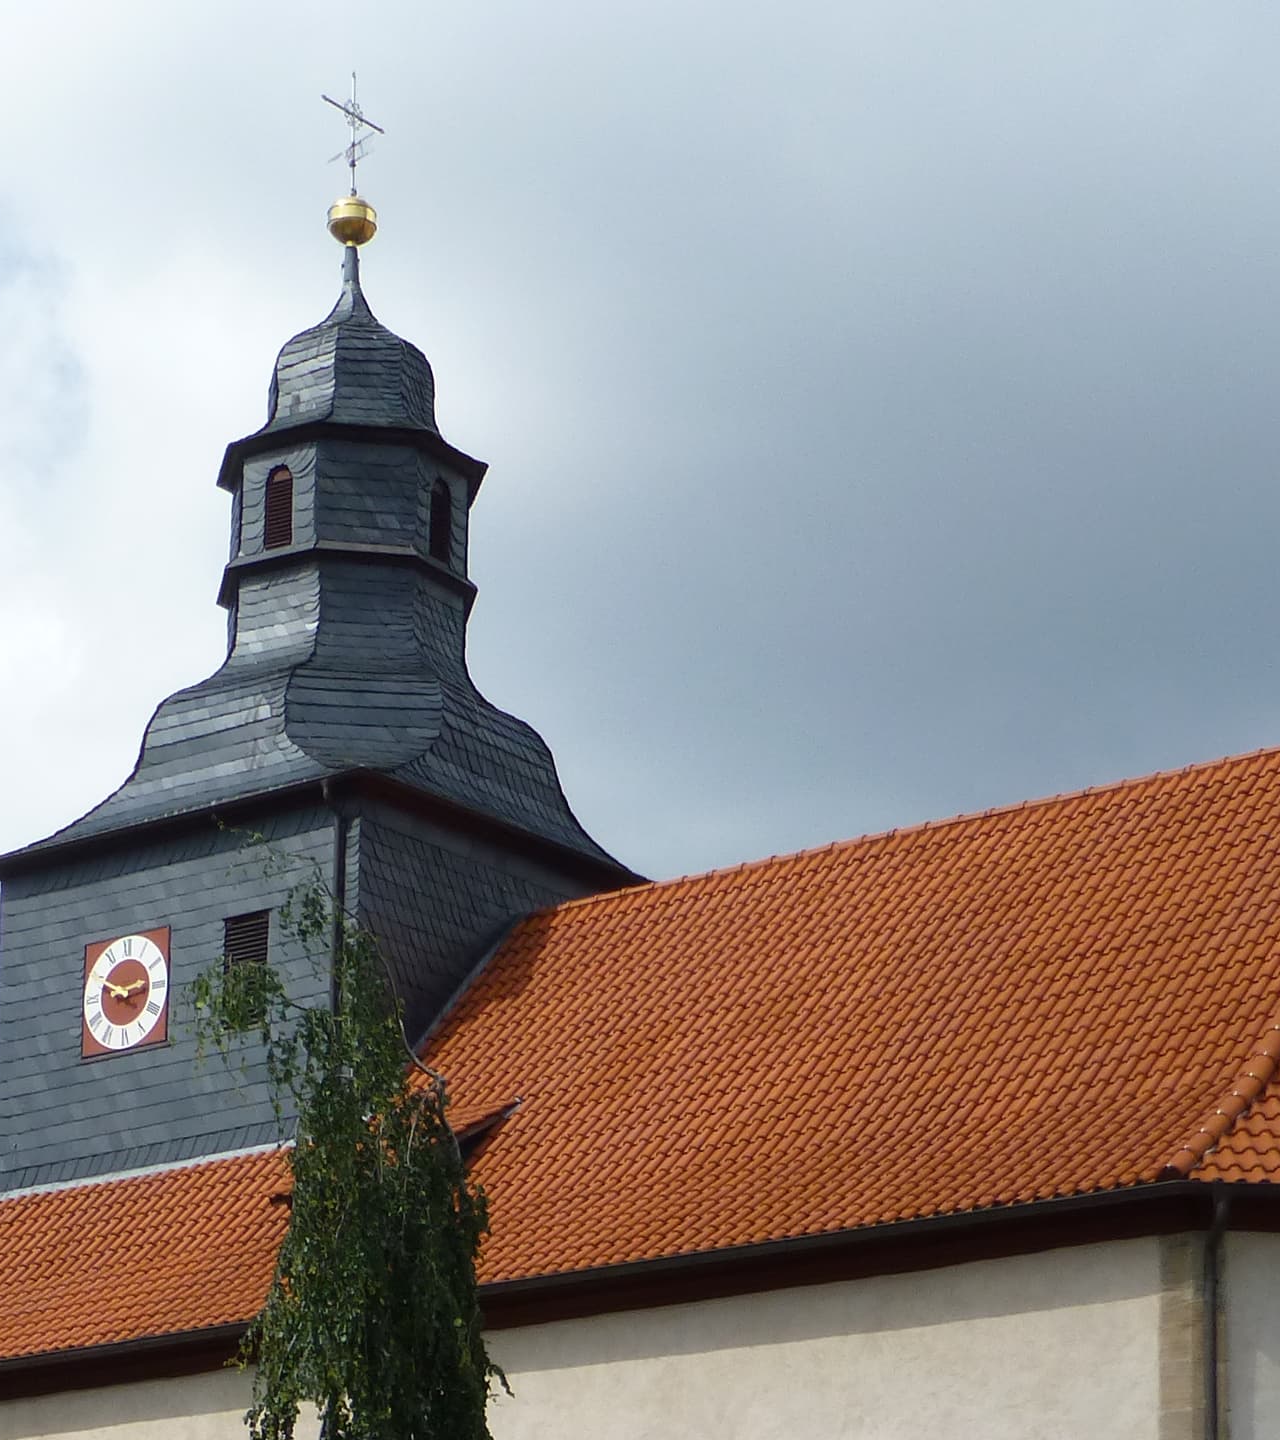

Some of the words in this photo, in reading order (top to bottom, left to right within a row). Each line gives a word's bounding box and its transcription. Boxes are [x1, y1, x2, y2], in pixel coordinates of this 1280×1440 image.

[140, 941, 148, 957] I
[149, 957, 161, 969] II
[152, 980, 166, 990] III
[137, 1020, 147, 1037] V
